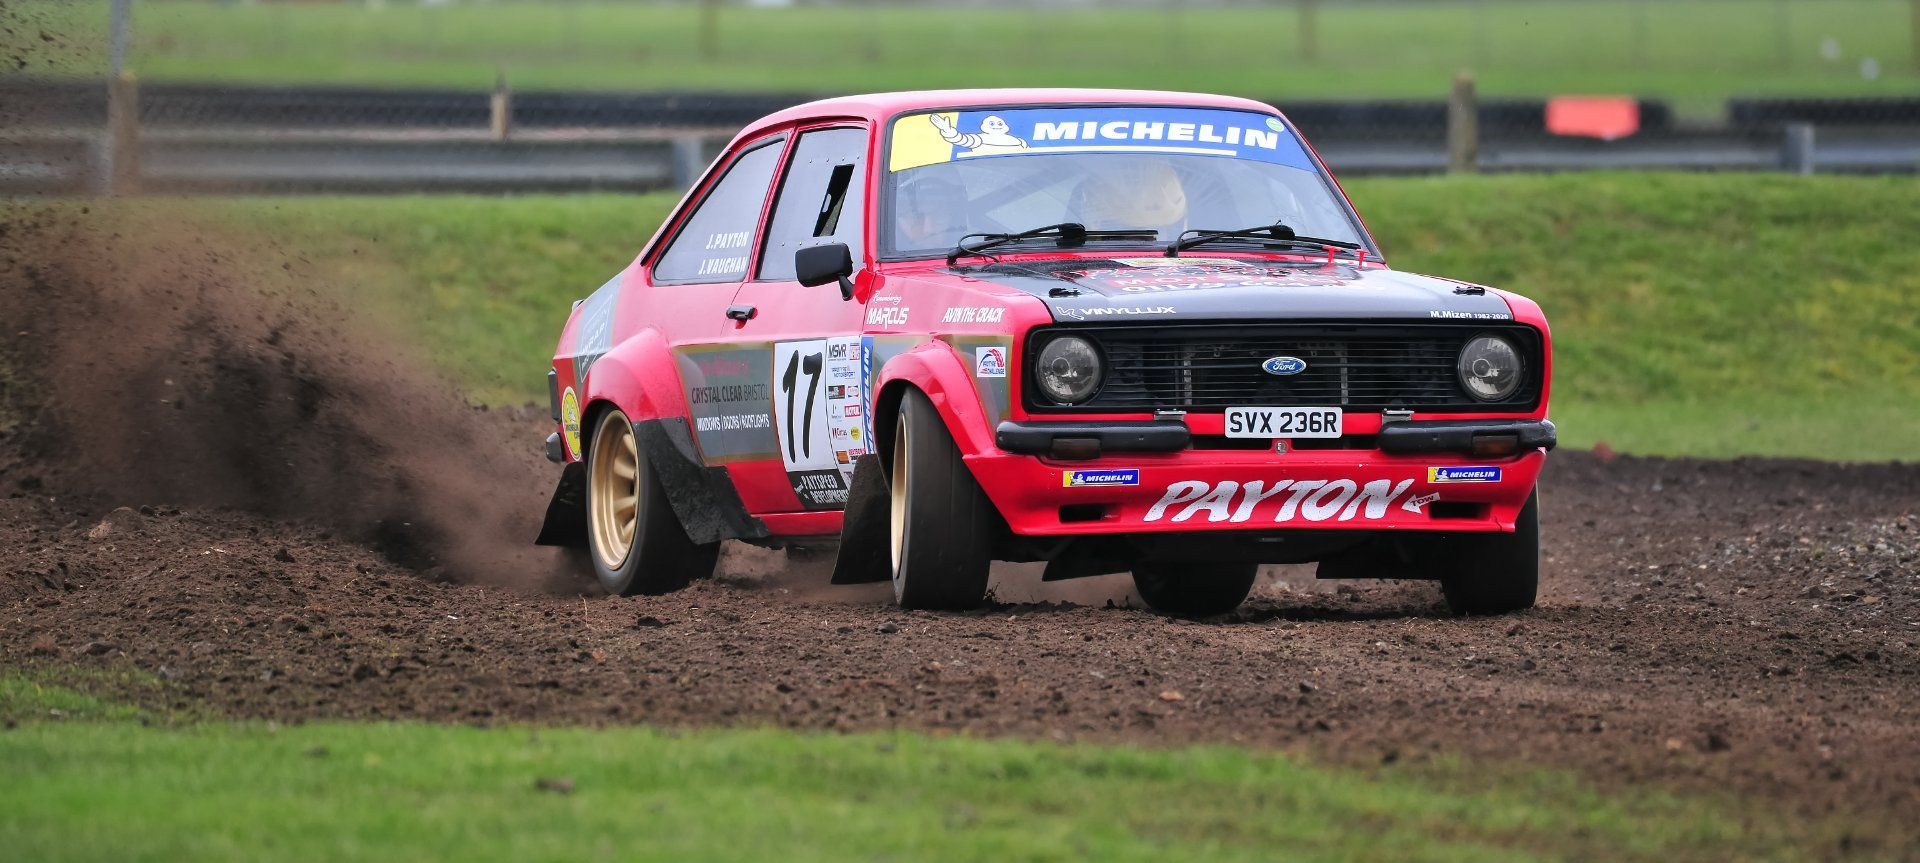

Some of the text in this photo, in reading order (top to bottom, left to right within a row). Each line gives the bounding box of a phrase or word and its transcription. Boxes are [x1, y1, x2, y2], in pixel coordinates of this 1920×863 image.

[1032, 121, 1278, 150] MICHELIN
[705, 231, 750, 250] J.PAYTON
[698, 256, 749, 275] J.VAUGHAN
[866, 307, 910, 330] MARCUS
[976, 307, 1006, 323] CRACK
[1080, 306, 1177, 316] VINYLLUX
[1430, 310, 1472, 319] M.Mizen
[1272, 360, 1296, 371] Ford
[691, 383, 770, 404] CRYSTAL CLEAR BRISTOL
[782, 349, 823, 464] 17
[696, 416, 721, 431] WINDOWS
[1229, 411, 1337, 433] SVX 236R
[1085, 474, 1133, 482] MICHELIN
[1449, 471, 1496, 479] MICHELIN
[1143, 477, 1415, 523] PAYTON
[1408, 495, 1434, 507] TOW
